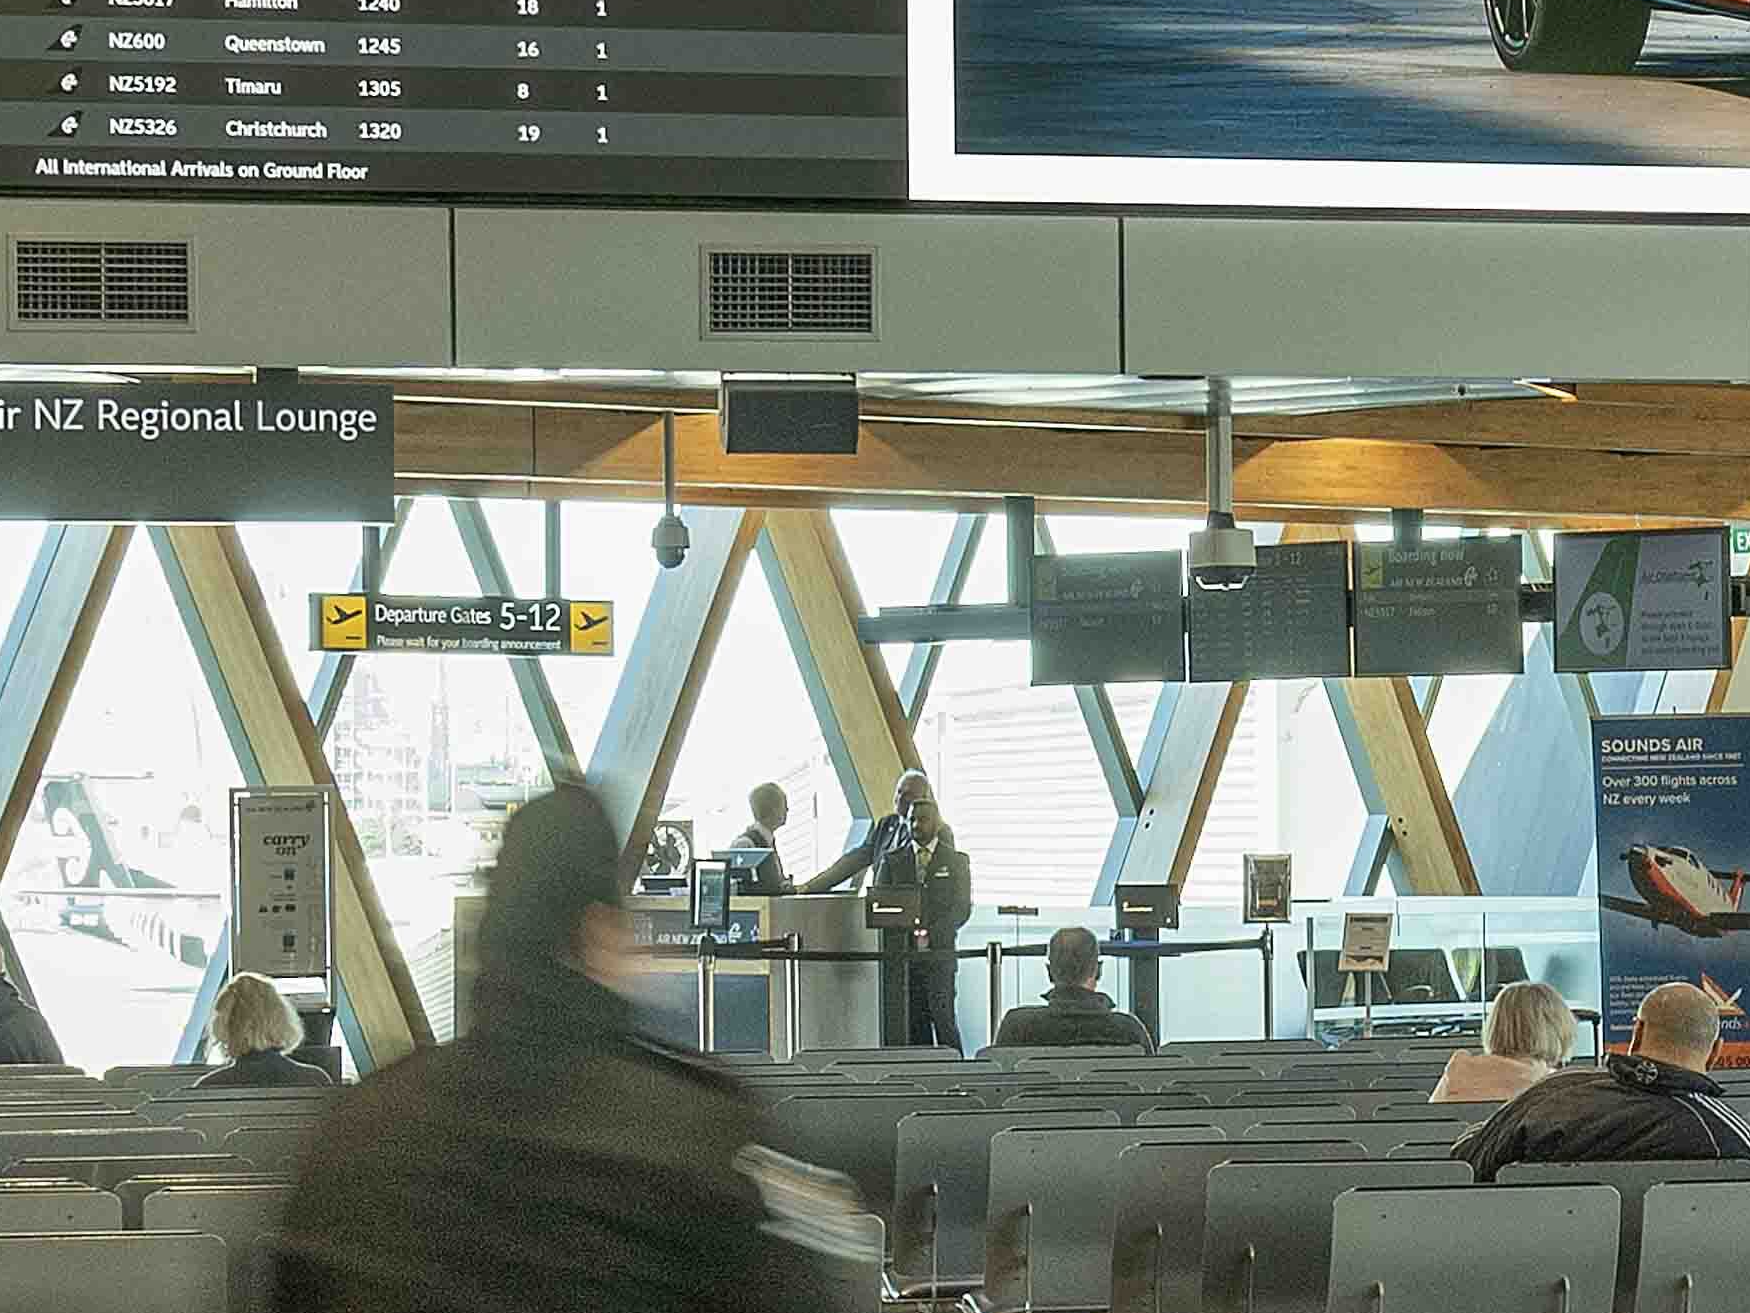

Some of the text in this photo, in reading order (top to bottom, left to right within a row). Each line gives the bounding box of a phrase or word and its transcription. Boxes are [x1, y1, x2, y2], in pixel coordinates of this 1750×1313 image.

[35, 158, 369, 180] All International Arrivals on Ground Floor
[34, 398, 84, 430] NZ
[98, 399, 244, 440] Regional
[257, 400, 377, 441] Lounge
[374, 602, 562, 631] Departure Gates 5-12
[376, 634, 562, 652] Please wait for your boarding announcement
[1601, 737, 1703, 753] SOUNDS AIR
[1602, 775, 1737, 788] Over 300 flights across
[1603, 792, 1690, 806] NZ every week
[263, 834, 310, 848] carry
